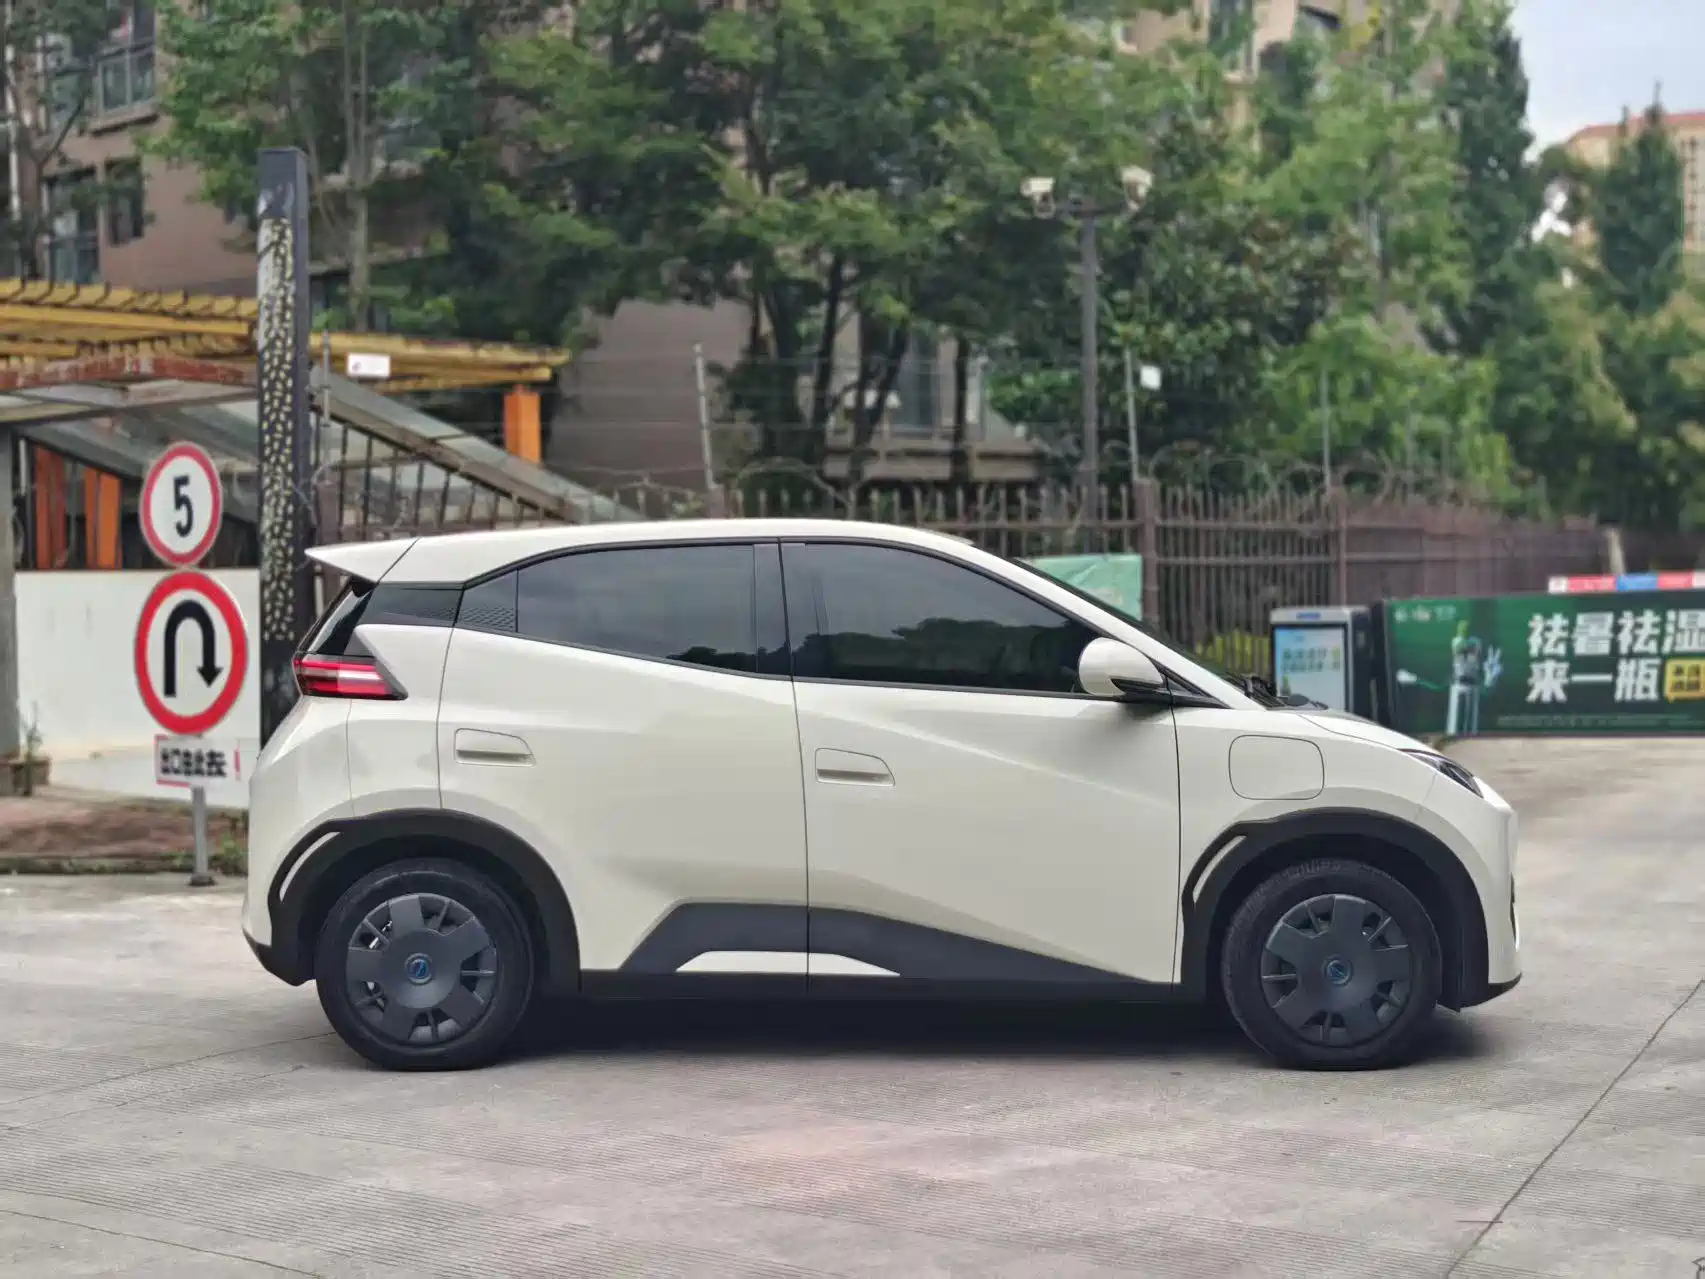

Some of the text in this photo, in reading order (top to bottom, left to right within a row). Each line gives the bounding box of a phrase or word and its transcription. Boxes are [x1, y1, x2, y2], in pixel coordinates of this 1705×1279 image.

[173, 475, 193, 537] 5
[1525, 658, 1661, 703] 来一瓶
